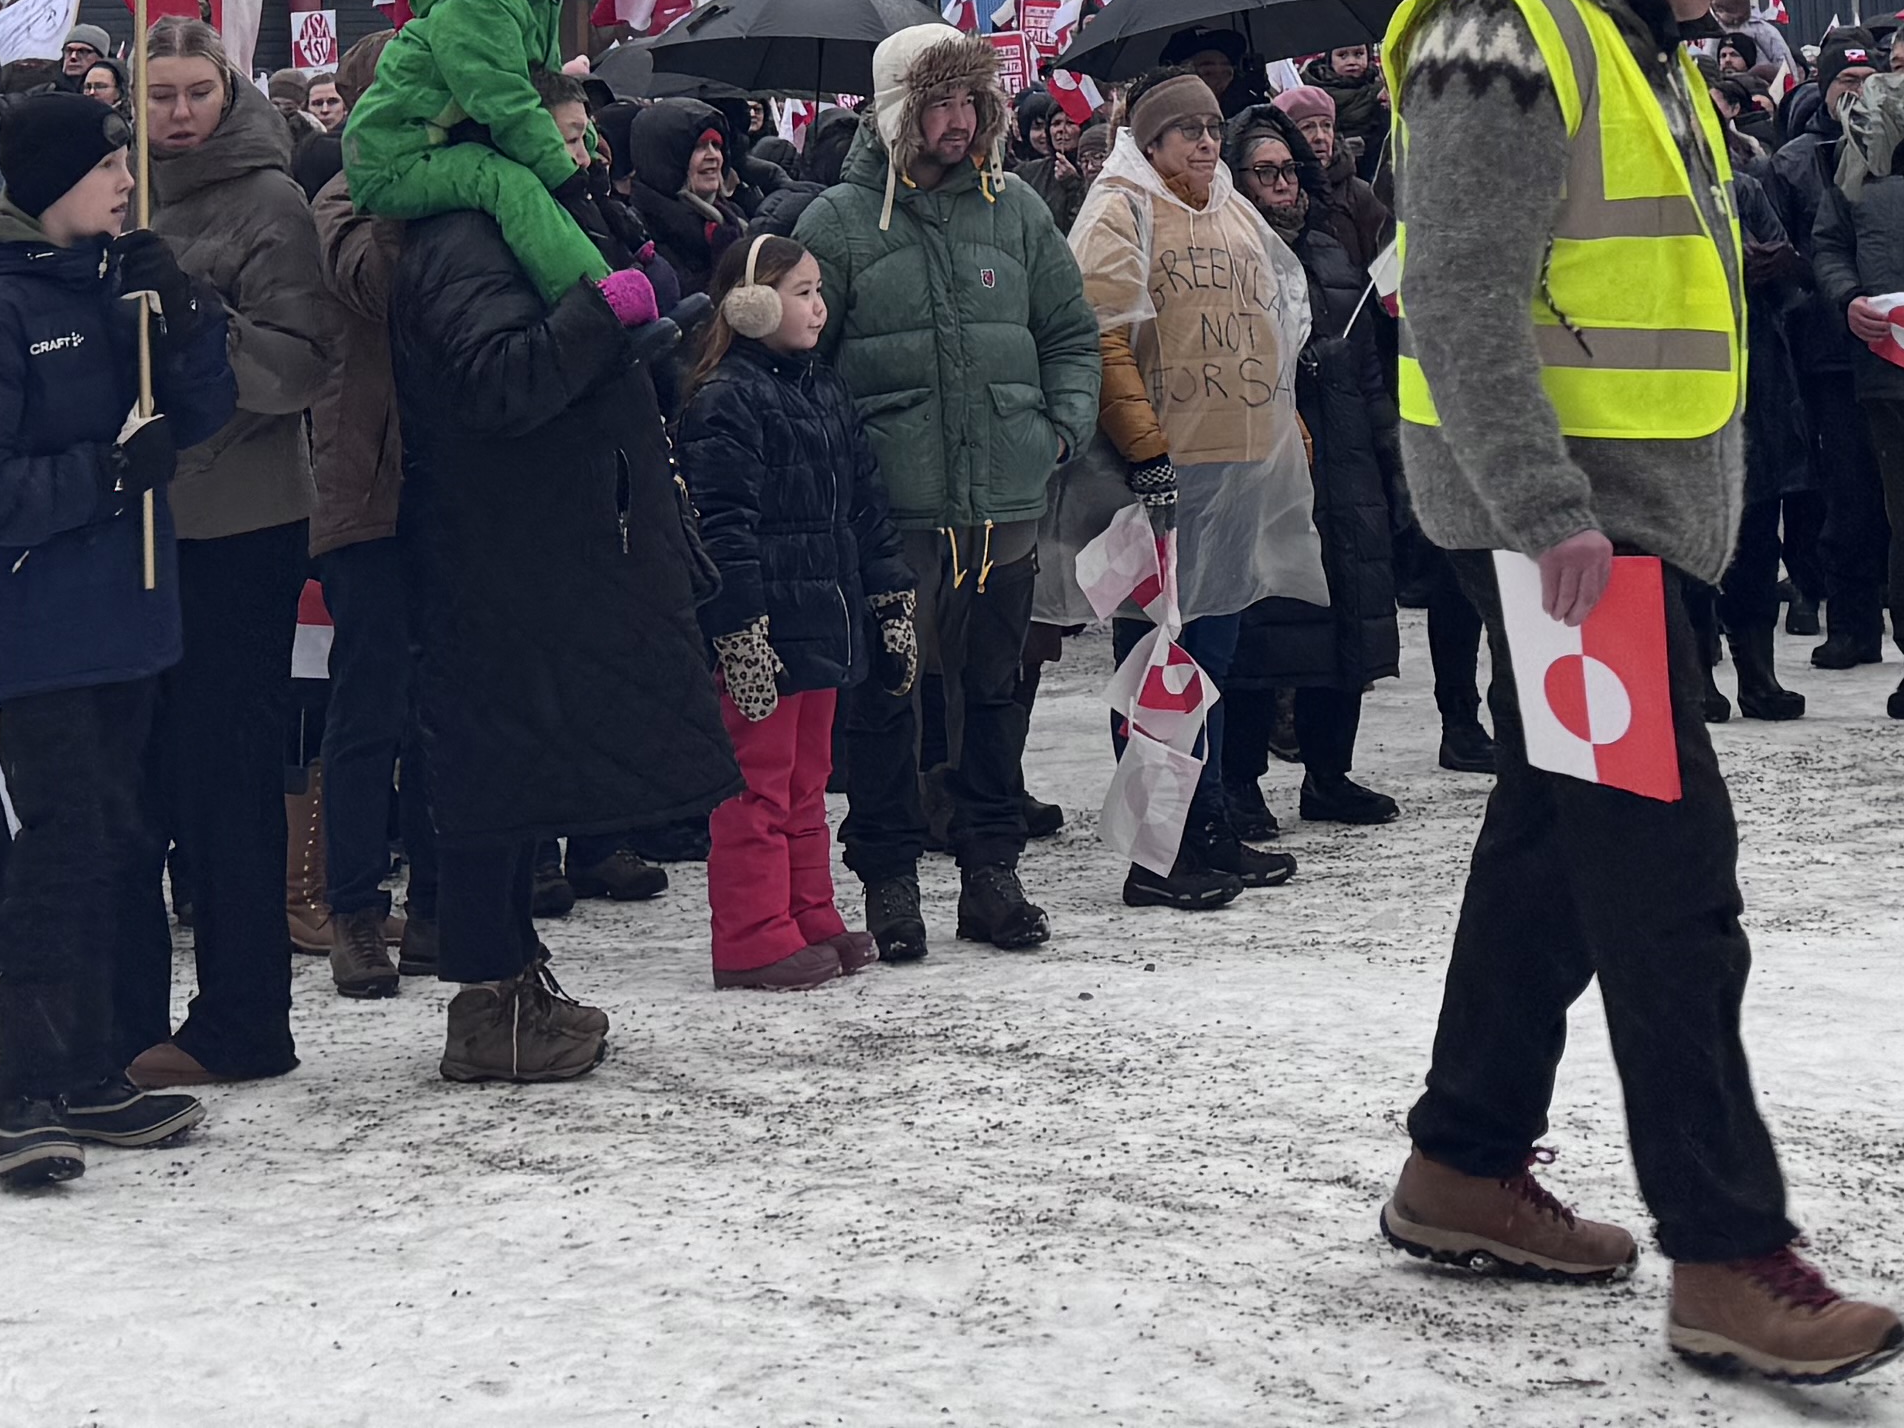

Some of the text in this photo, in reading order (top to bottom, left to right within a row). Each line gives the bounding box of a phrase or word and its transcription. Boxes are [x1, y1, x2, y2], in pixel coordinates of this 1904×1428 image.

[29, 337, 71, 355] CRAFT
[1201, 312, 1262, 353] NOT
[1150, 362, 1228, 403] FOR
